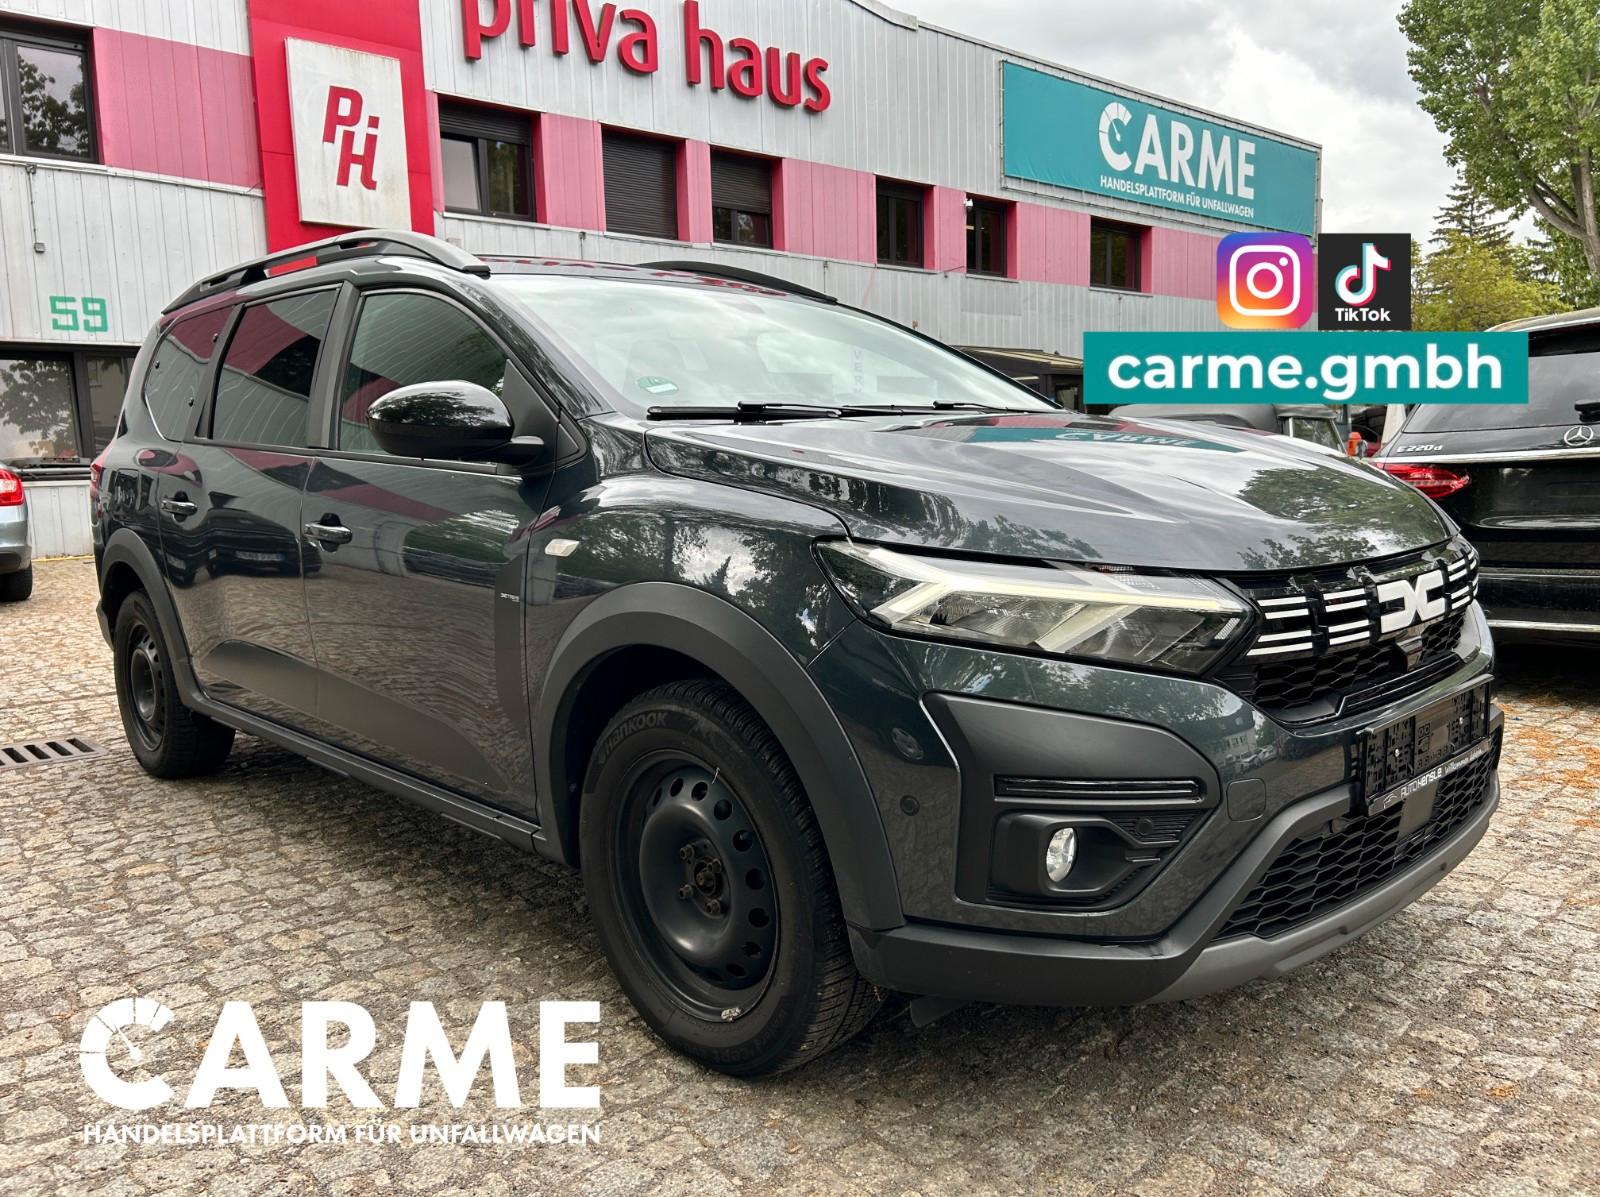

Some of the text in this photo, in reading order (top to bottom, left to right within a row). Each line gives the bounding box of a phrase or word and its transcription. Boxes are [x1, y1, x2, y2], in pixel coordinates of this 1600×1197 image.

[684, 0, 832, 114] haus
[1098, 101, 1256, 200] CARME
[1100, 175, 1255, 219] HANDELSPLATTFORM FÜR UNFALLWAGEN
[49, 295, 109, 333] 59
